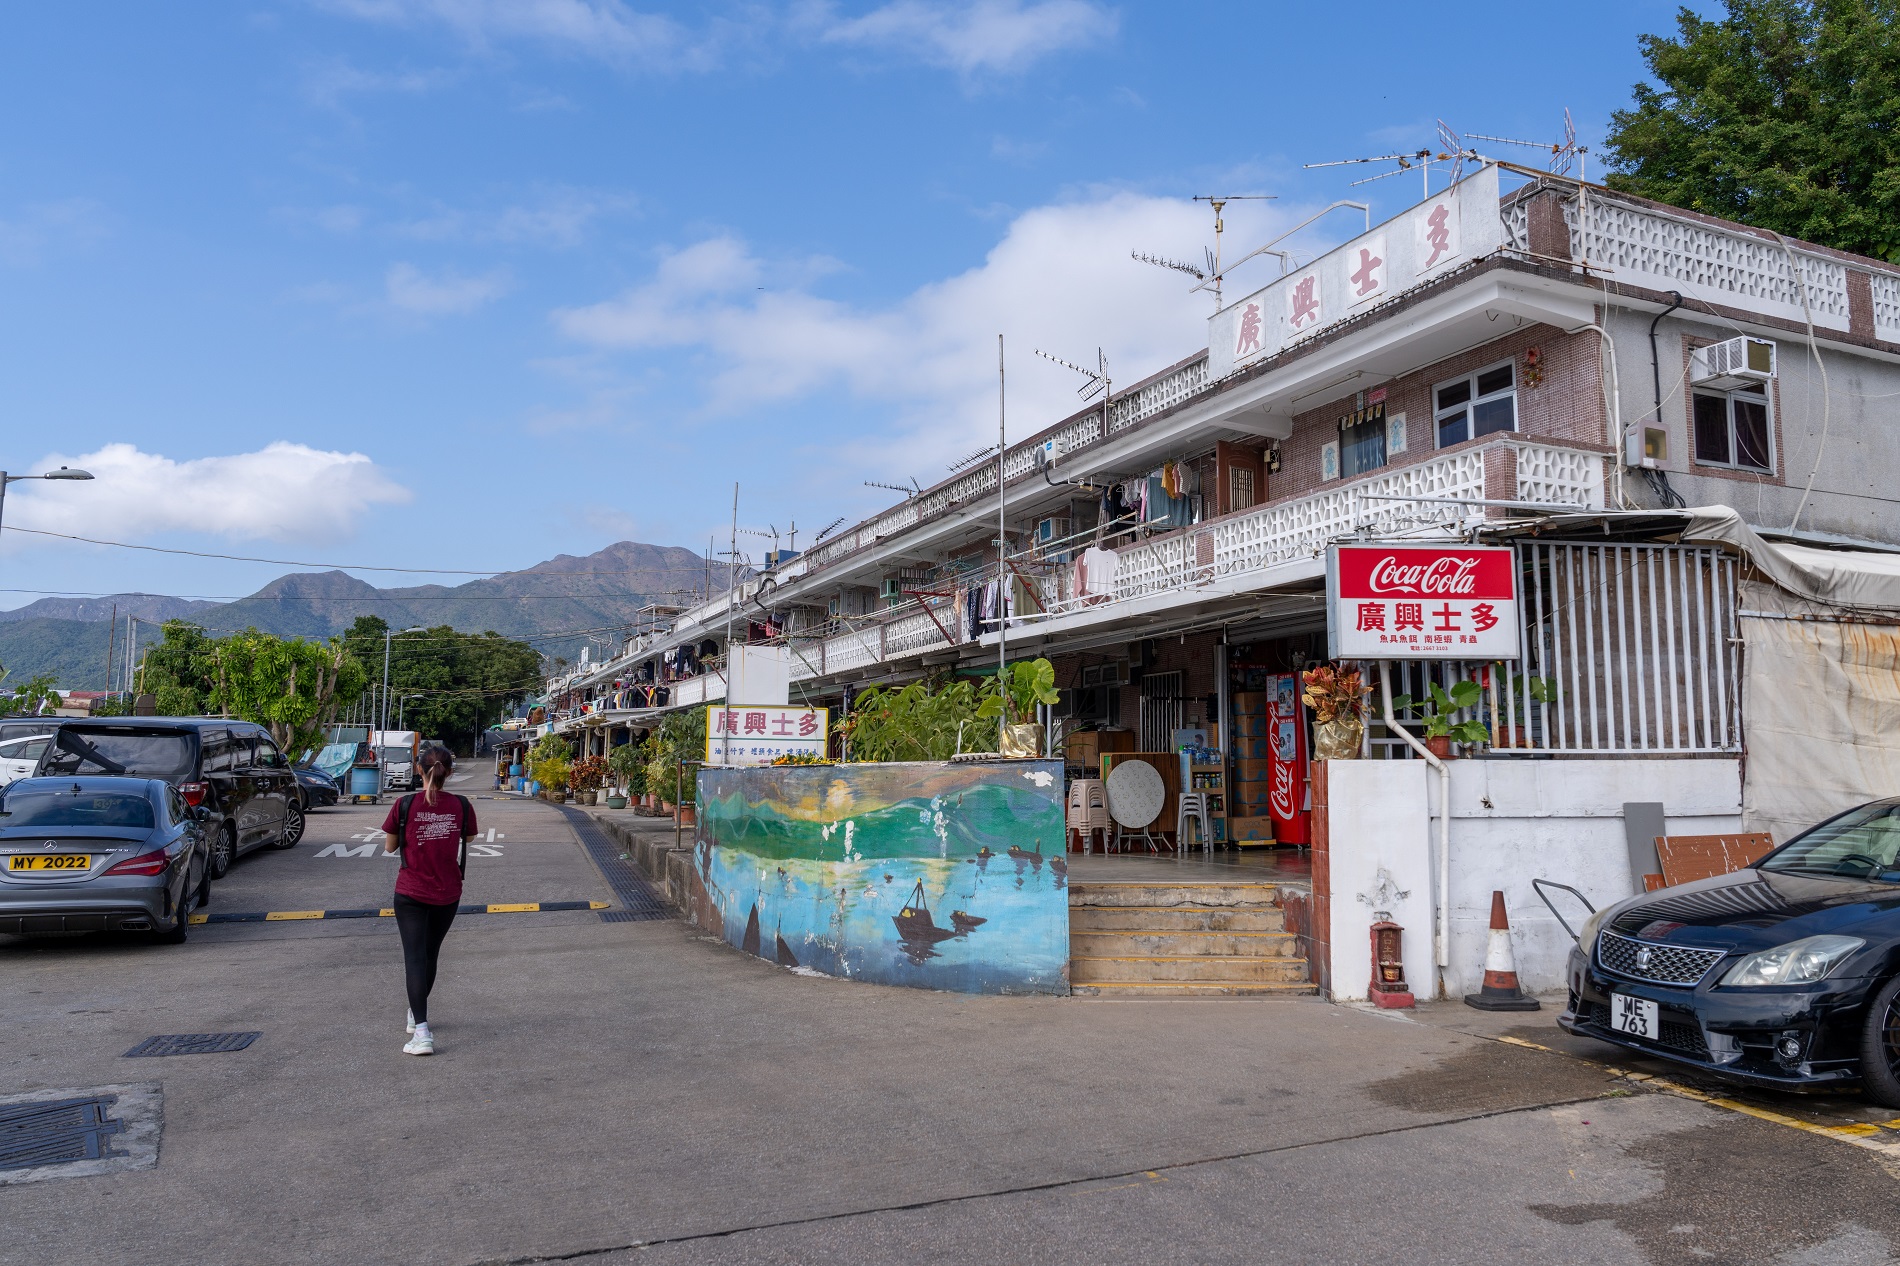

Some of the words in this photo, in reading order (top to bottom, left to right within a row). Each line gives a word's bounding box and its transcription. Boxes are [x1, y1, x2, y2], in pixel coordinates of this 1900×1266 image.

[1236, 204, 1450, 355] 廣興士多
[1369, 556, 1482, 595] Coca-Cola
[1355, 602, 1500, 633] 廣興士多
[716, 711, 818, 737] 廣興士多
[13, 858, 35, 868] MY
[44, 857, 86, 868] 2022
[1624, 997, 1644, 1017] ME
[1620, 1013, 1648, 1036] 763
